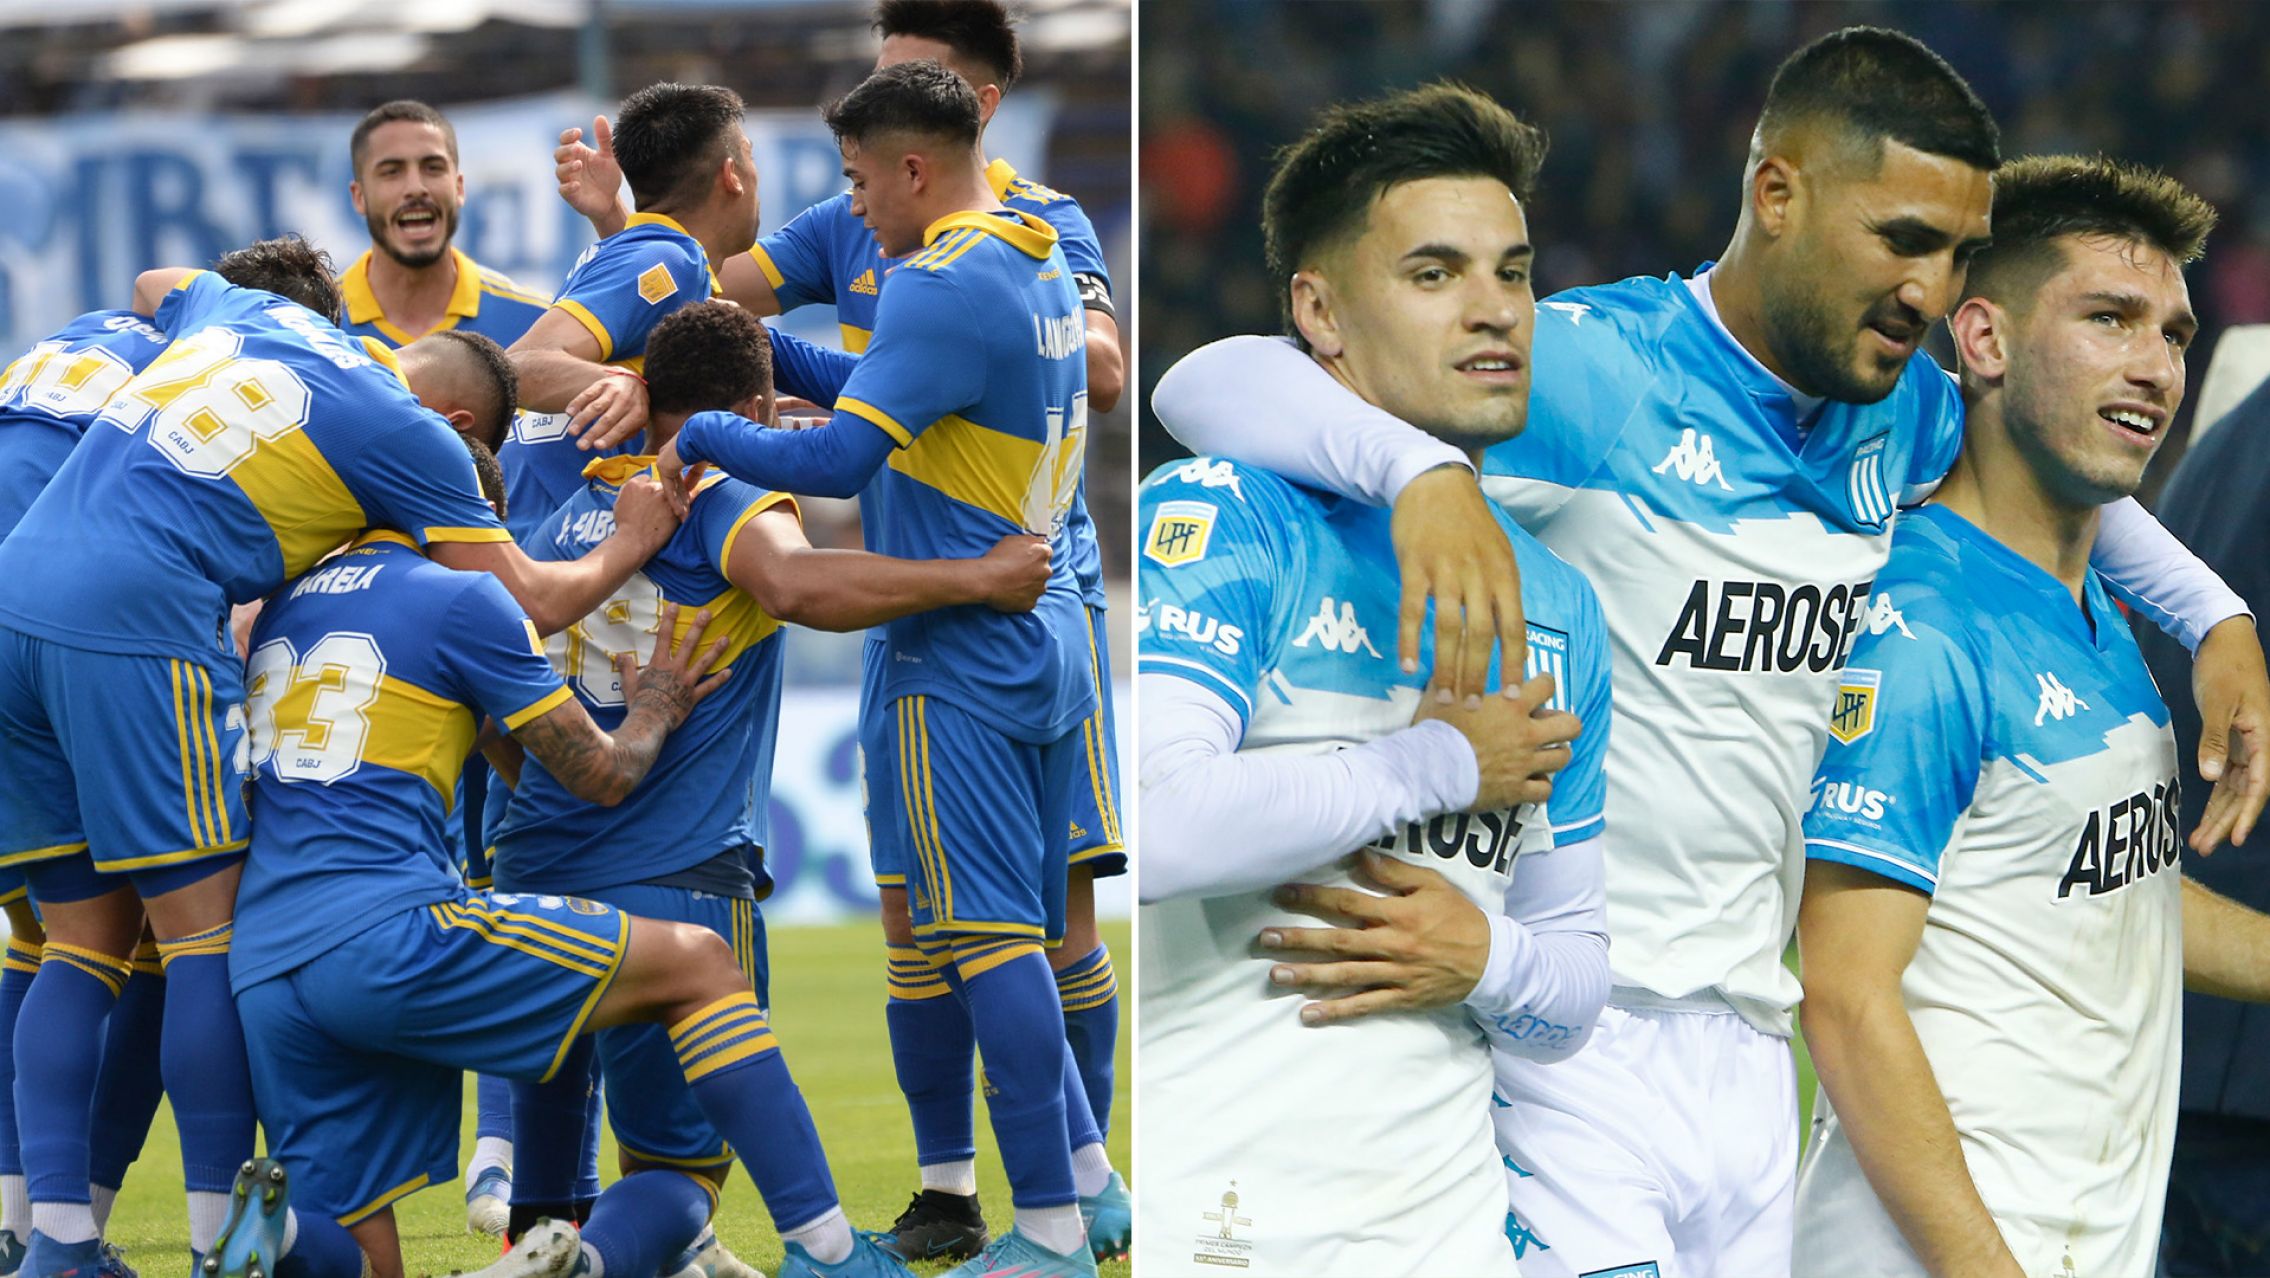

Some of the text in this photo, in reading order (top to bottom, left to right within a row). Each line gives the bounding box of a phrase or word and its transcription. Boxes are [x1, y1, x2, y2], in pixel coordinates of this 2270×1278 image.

[167, 430, 195, 455] CABJ
[1157, 522, 1200, 556] LPF
[1159, 603, 1245, 656] RUS
[1656, 579, 1872, 673] AEROSE
[245, 631, 388, 786] 33
[296, 758, 322, 769] CABJ
[1819, 781, 1888, 821] RUS
